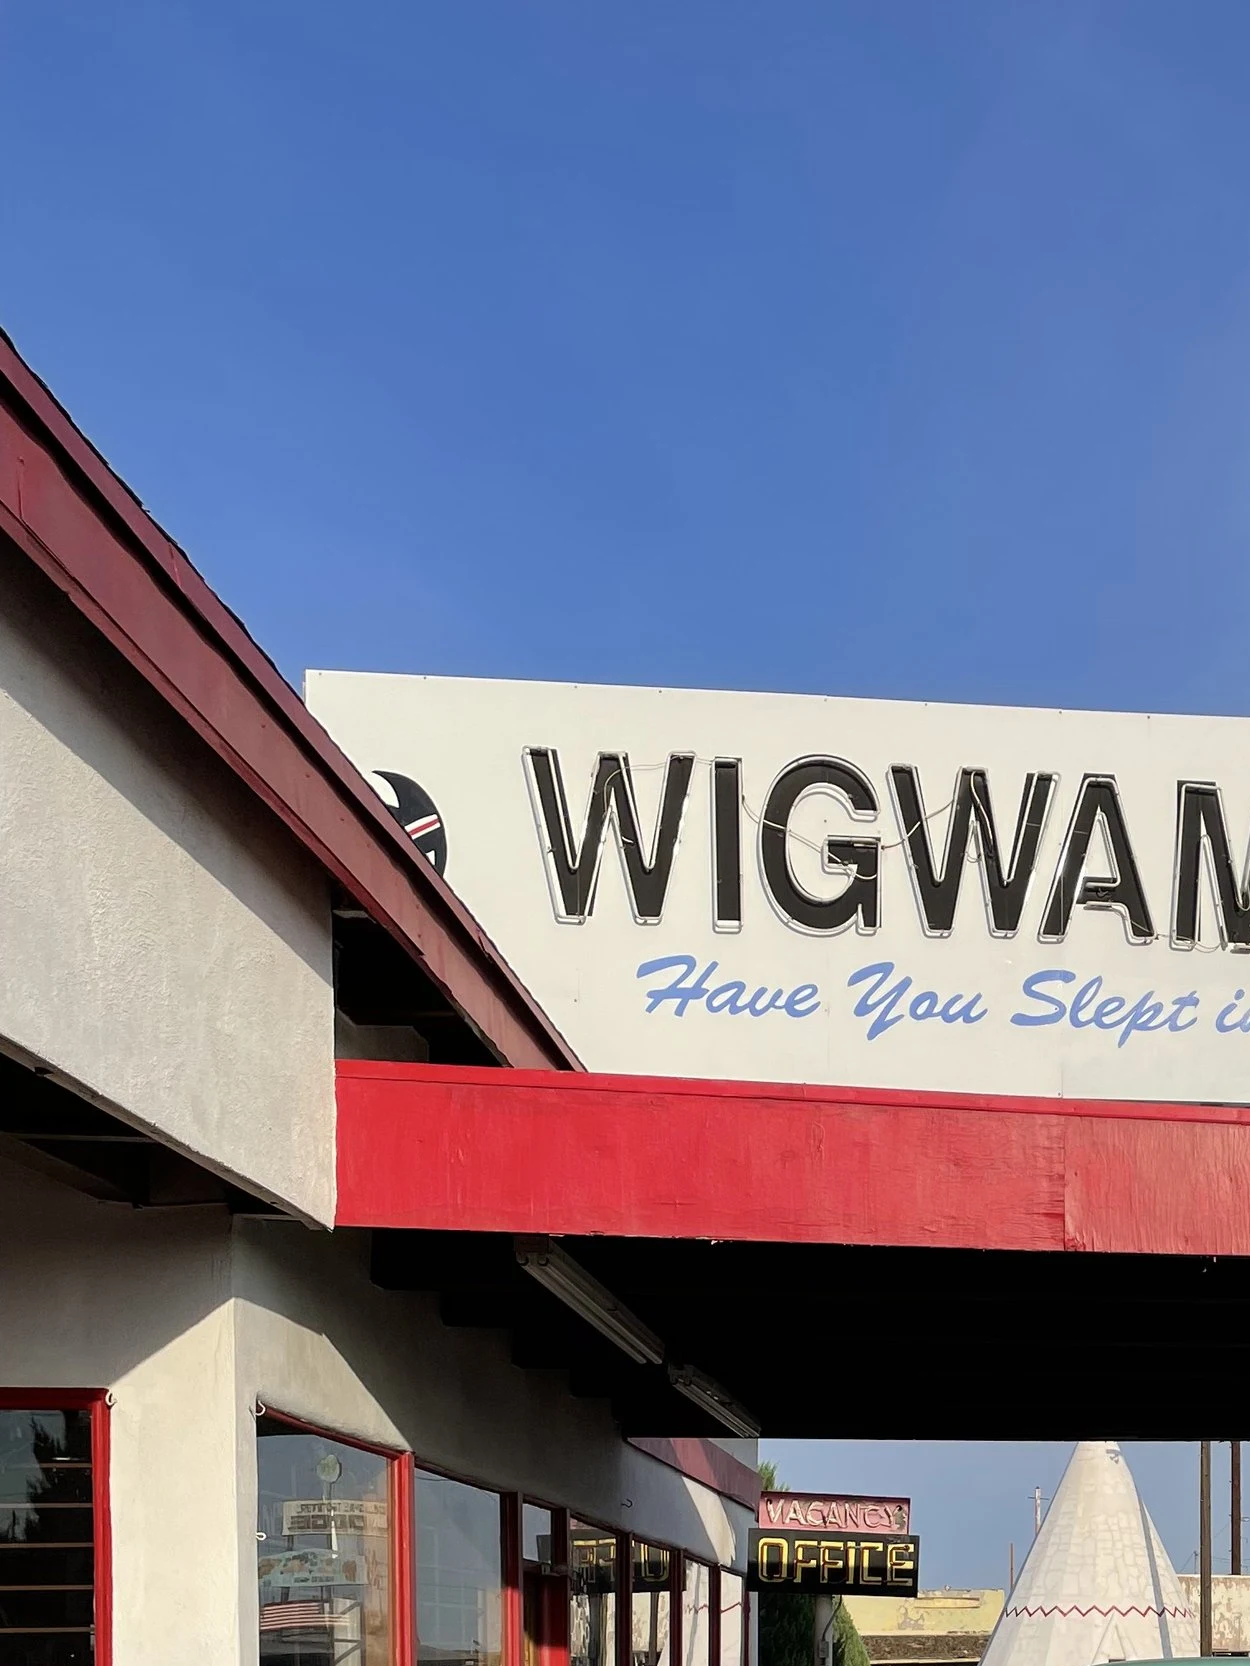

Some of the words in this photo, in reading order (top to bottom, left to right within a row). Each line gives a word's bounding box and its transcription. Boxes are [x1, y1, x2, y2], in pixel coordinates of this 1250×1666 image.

[636, 954, 821, 1018] Have
[847, 961, 988, 1041] You
[1010, 969, 1200, 1049] Slept
[764, 1497, 906, 1529] VACANCY
[758, 1537, 915, 1587] OFFICE
